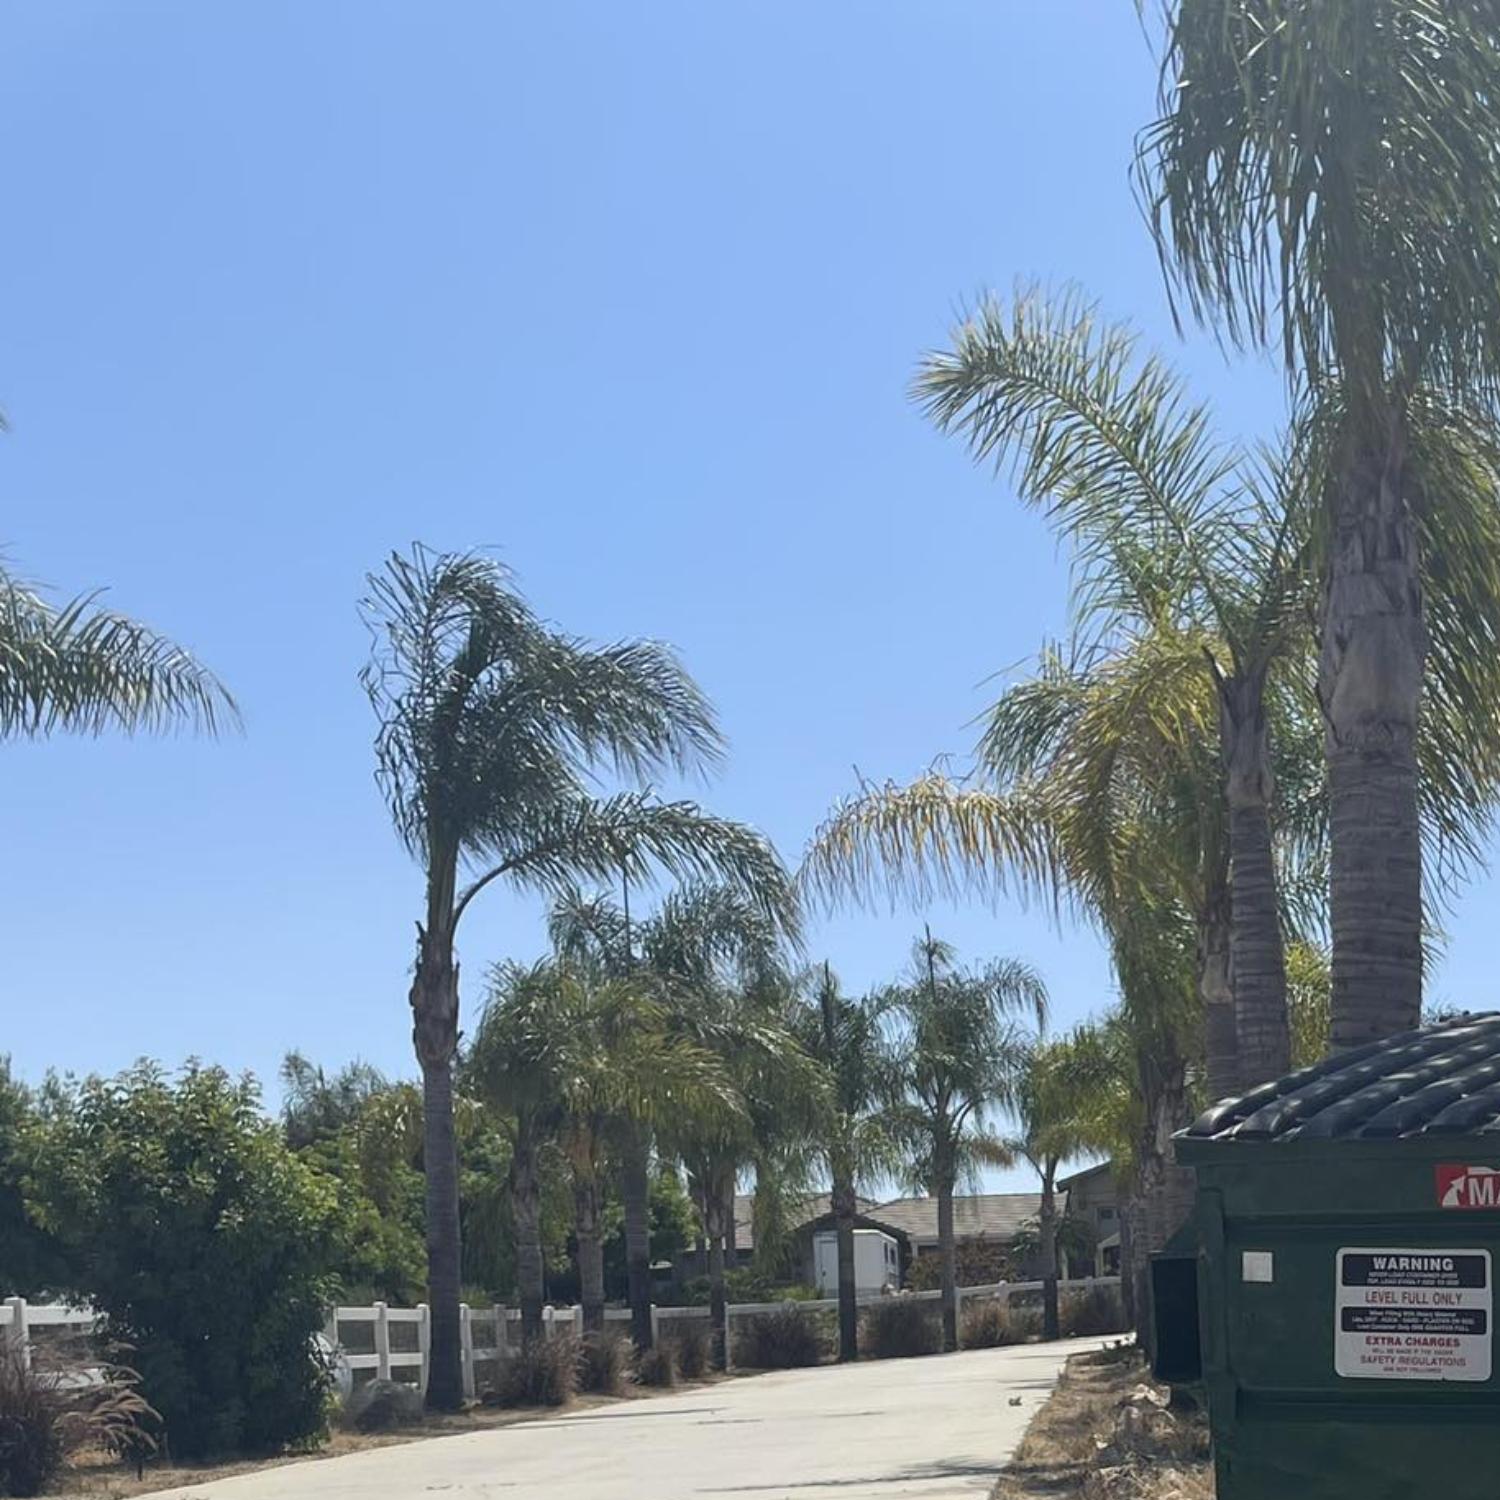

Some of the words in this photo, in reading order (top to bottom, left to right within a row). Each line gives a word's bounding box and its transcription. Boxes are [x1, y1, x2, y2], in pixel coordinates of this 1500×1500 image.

[1372, 1256, 1455, 1271] WARNING
[1365, 1290, 1398, 1303] LEVEL
[1402, 1291, 1429, 1304] FULL
[1432, 1292, 1463, 1305] ONLY
[1365, 1335, 1402, 1346] EXTRA
[1404, 1336, 1461, 1348] CHARGES
[1360, 1354, 1396, 1364] SAFETY
[1398, 1355, 1467, 1366] REGULATIONS
